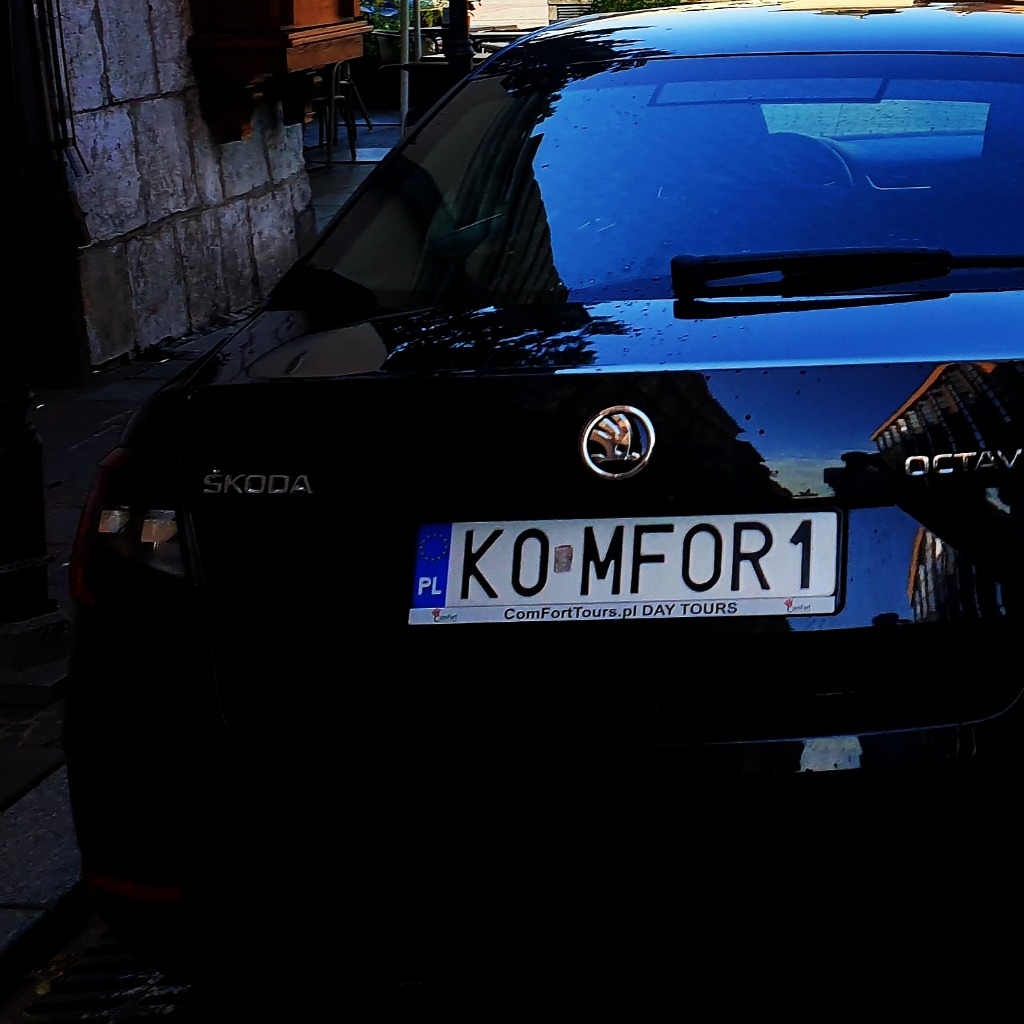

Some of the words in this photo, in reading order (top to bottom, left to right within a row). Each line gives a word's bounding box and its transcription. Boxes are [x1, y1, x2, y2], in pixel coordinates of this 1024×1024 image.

[203, 469, 313, 494] ŠKODA
[460, 528, 550, 600] KO
[580, 519, 813, 596] MFOR1
[418, 576, 442, 596] PL
[504, 605, 637, 620] ComFortTours.pl
[642, 604, 676, 616] DAY
[680, 602, 738, 615] TOURS
